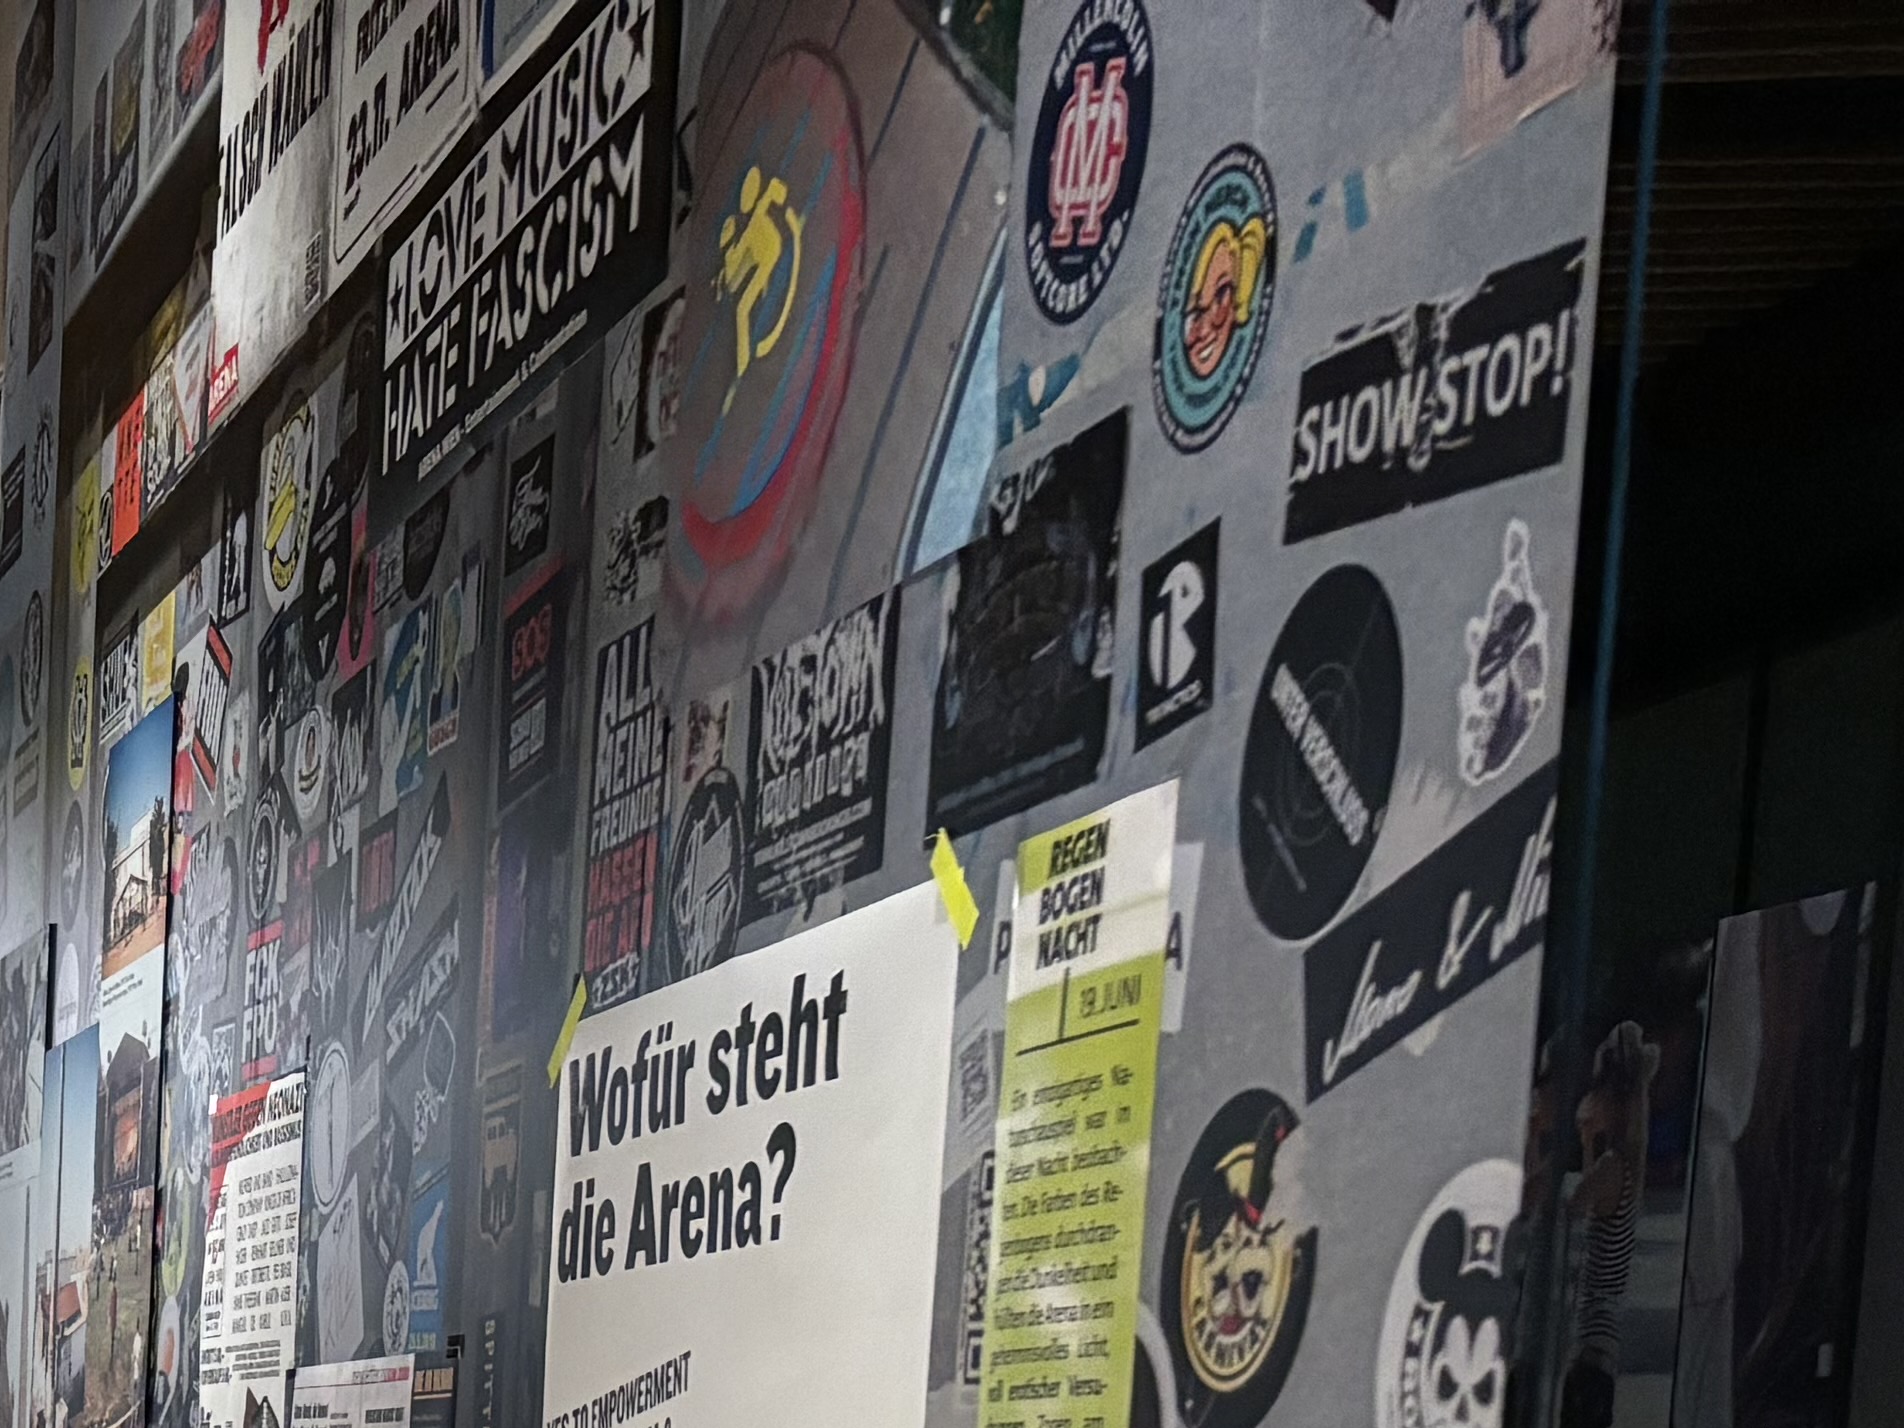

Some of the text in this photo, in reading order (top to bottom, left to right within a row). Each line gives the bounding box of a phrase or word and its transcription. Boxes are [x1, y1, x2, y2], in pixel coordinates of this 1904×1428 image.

[402, 150, 488, 343] LOVE
[497, 1, 626, 240] MUSIC
[383, 302, 461, 476] HATE
[468, 111, 645, 387] FASCISM
[1292, 308, 1570, 482] SHOW STOP!
[599, 624, 652, 732] ALL
[1038, 866, 1105, 925] BOGEN
[1048, 818, 1111, 880] REGEN
[244, 939, 281, 1005] FCK
[1036, 912, 1102, 970] NACHT
[569, 969, 848, 1157] Wofür steht
[557, 1122, 797, 1284] die Arena?
